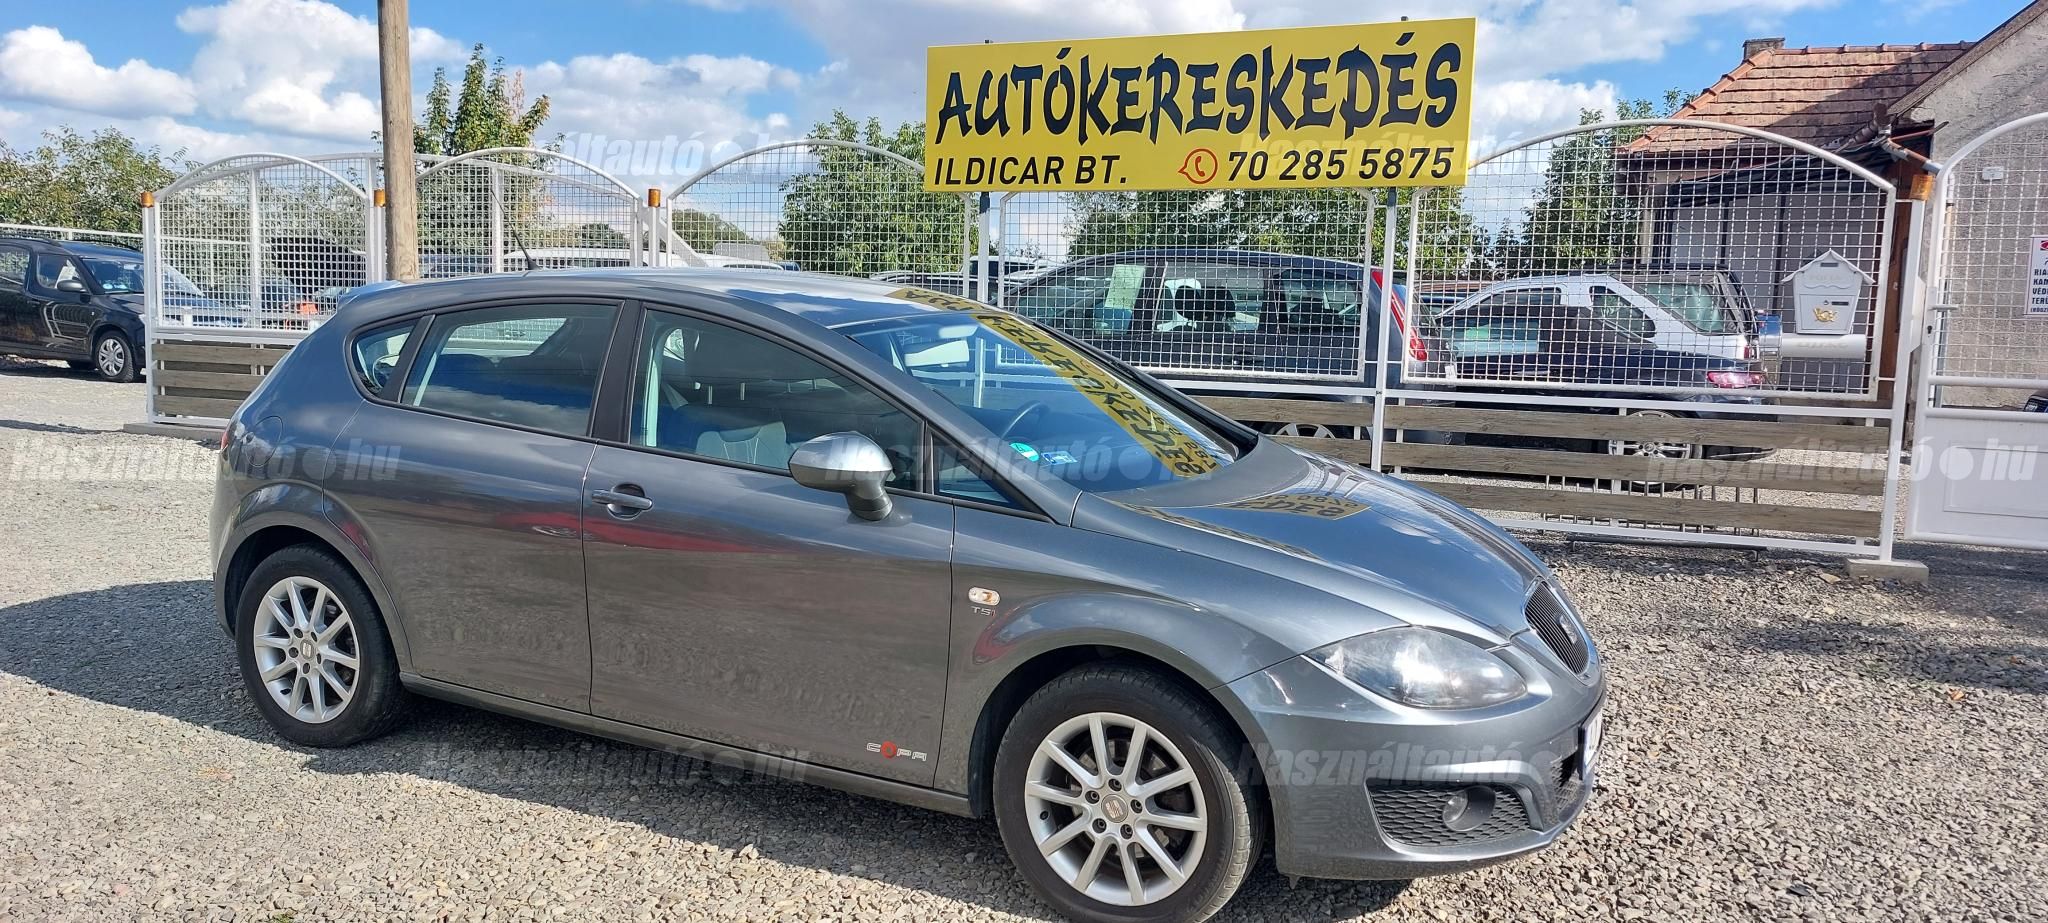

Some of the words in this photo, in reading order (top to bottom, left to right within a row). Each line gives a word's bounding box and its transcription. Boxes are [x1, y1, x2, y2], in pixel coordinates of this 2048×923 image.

[934, 32, 1461, 145] AUTÓKERESKEDÉS
[934, 156, 1065, 185] ILDICAR
[1075, 155, 1127, 184] BT.
[1228, 150, 1269, 181] 70
[1279, 149, 1347, 181] 285
[1358, 147, 1455, 180] 5875
[866, 740, 928, 762] COPA
